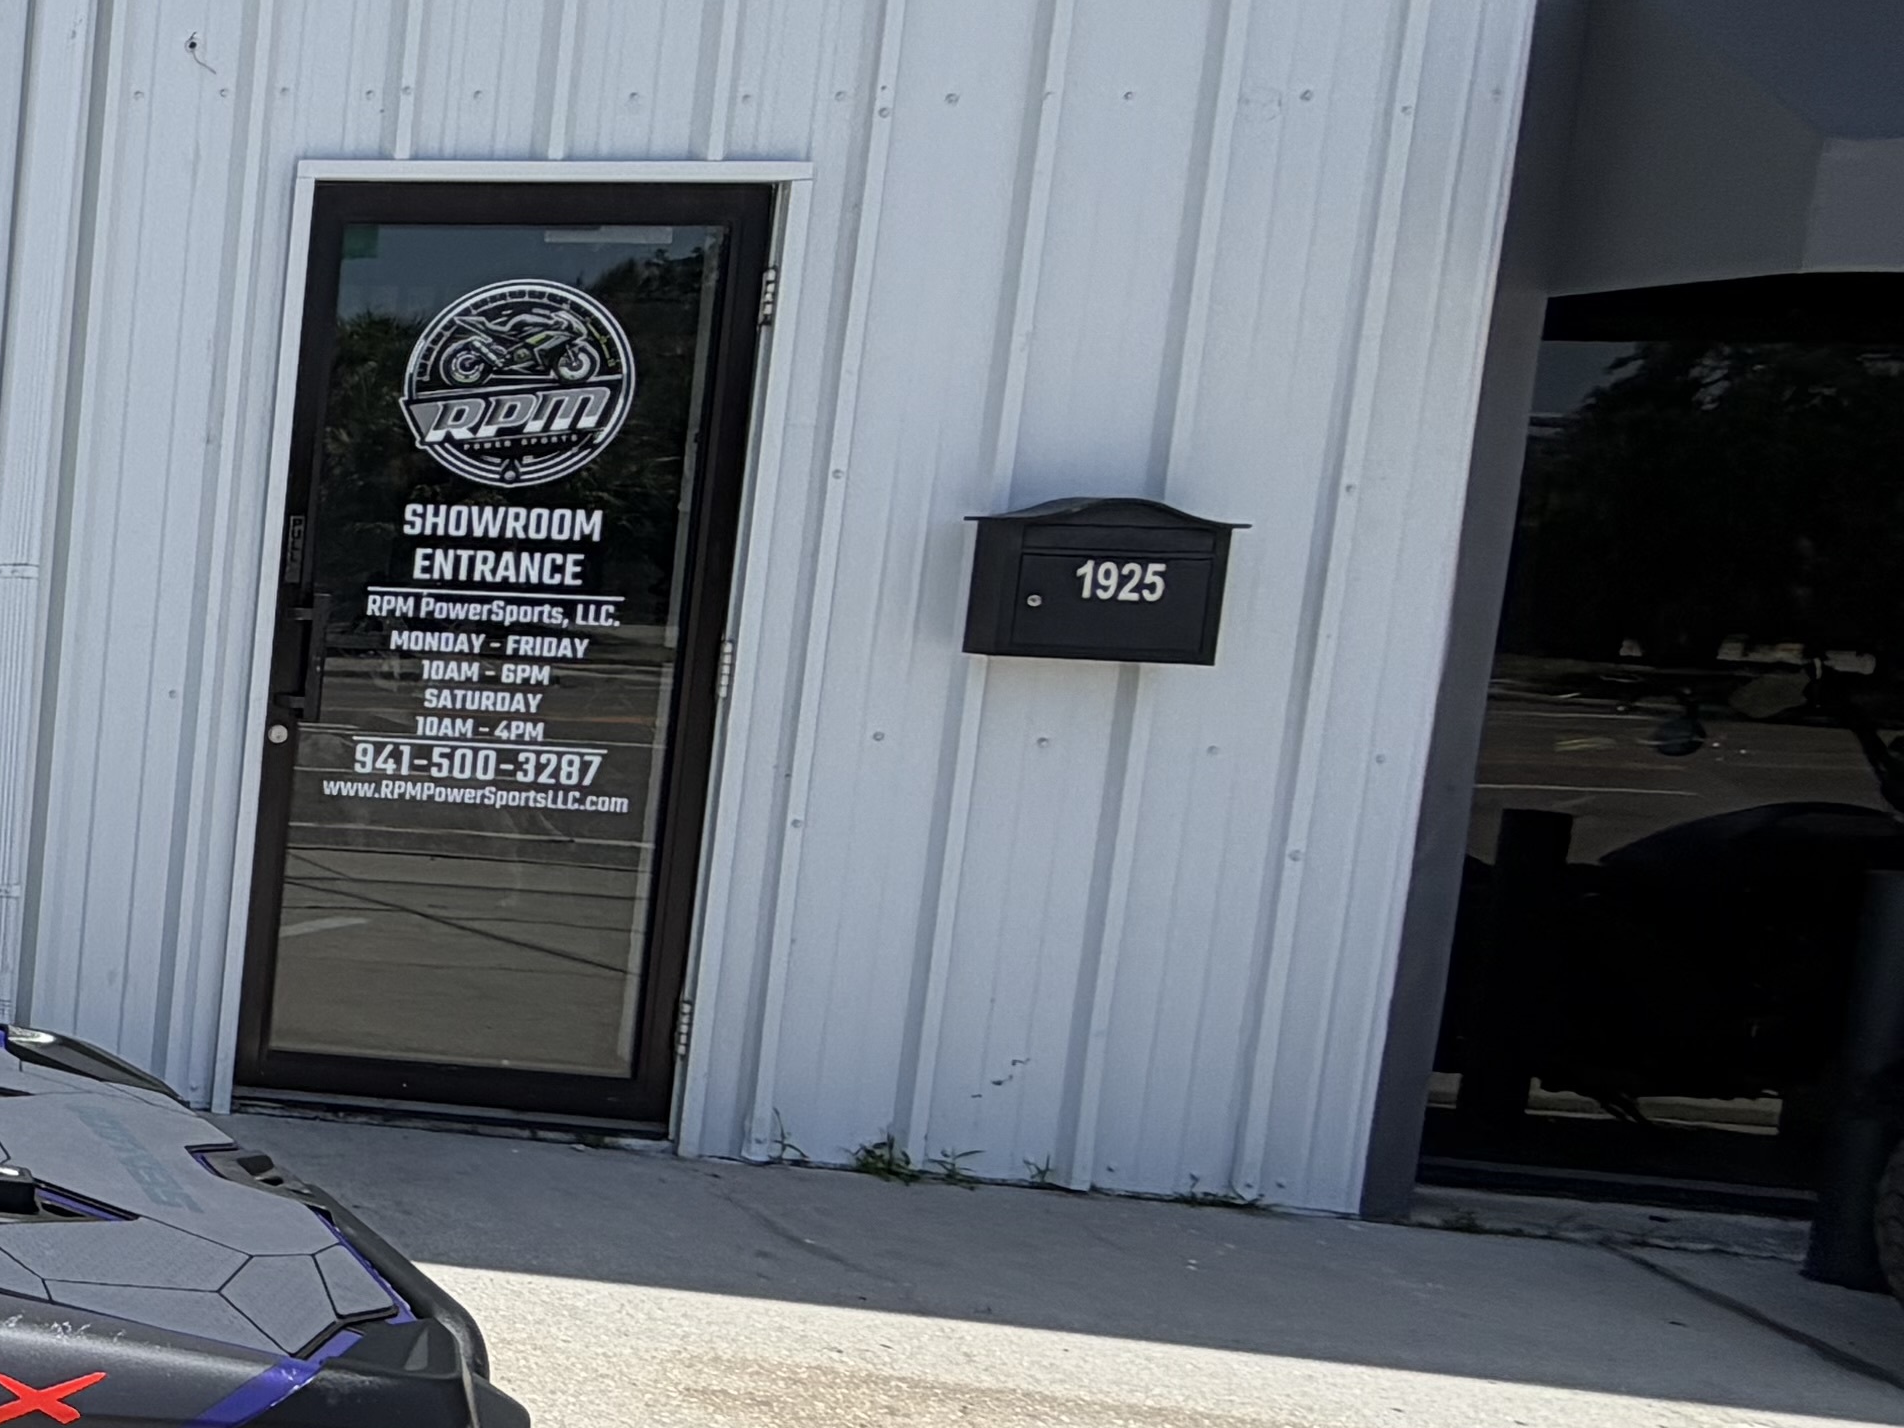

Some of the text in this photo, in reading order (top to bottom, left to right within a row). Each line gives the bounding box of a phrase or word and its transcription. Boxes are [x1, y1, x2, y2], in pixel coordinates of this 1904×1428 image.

[424, 386, 611, 442] RPM
[403, 503, 603, 542] SHOWROOM
[412, 547, 585, 586] ENTRANCE
[1076, 559, 1167, 602] 1925
[366, 594, 621, 627] RPM PowerSports, LLC.
[390, 630, 485, 654] MONDAY
[506, 635, 590, 659] FRIDAY
[422, 659, 480, 682] 10AM
[501, 663, 550, 686] 6PM
[423, 688, 543, 714] SATURDAY
[415, 715, 474, 738] 10AM
[494, 720, 545, 742] 4PM
[354, 743, 603, 787] 941-500-3287
[323, 779, 629, 813] www.RPMPowerSportsLLC.com
